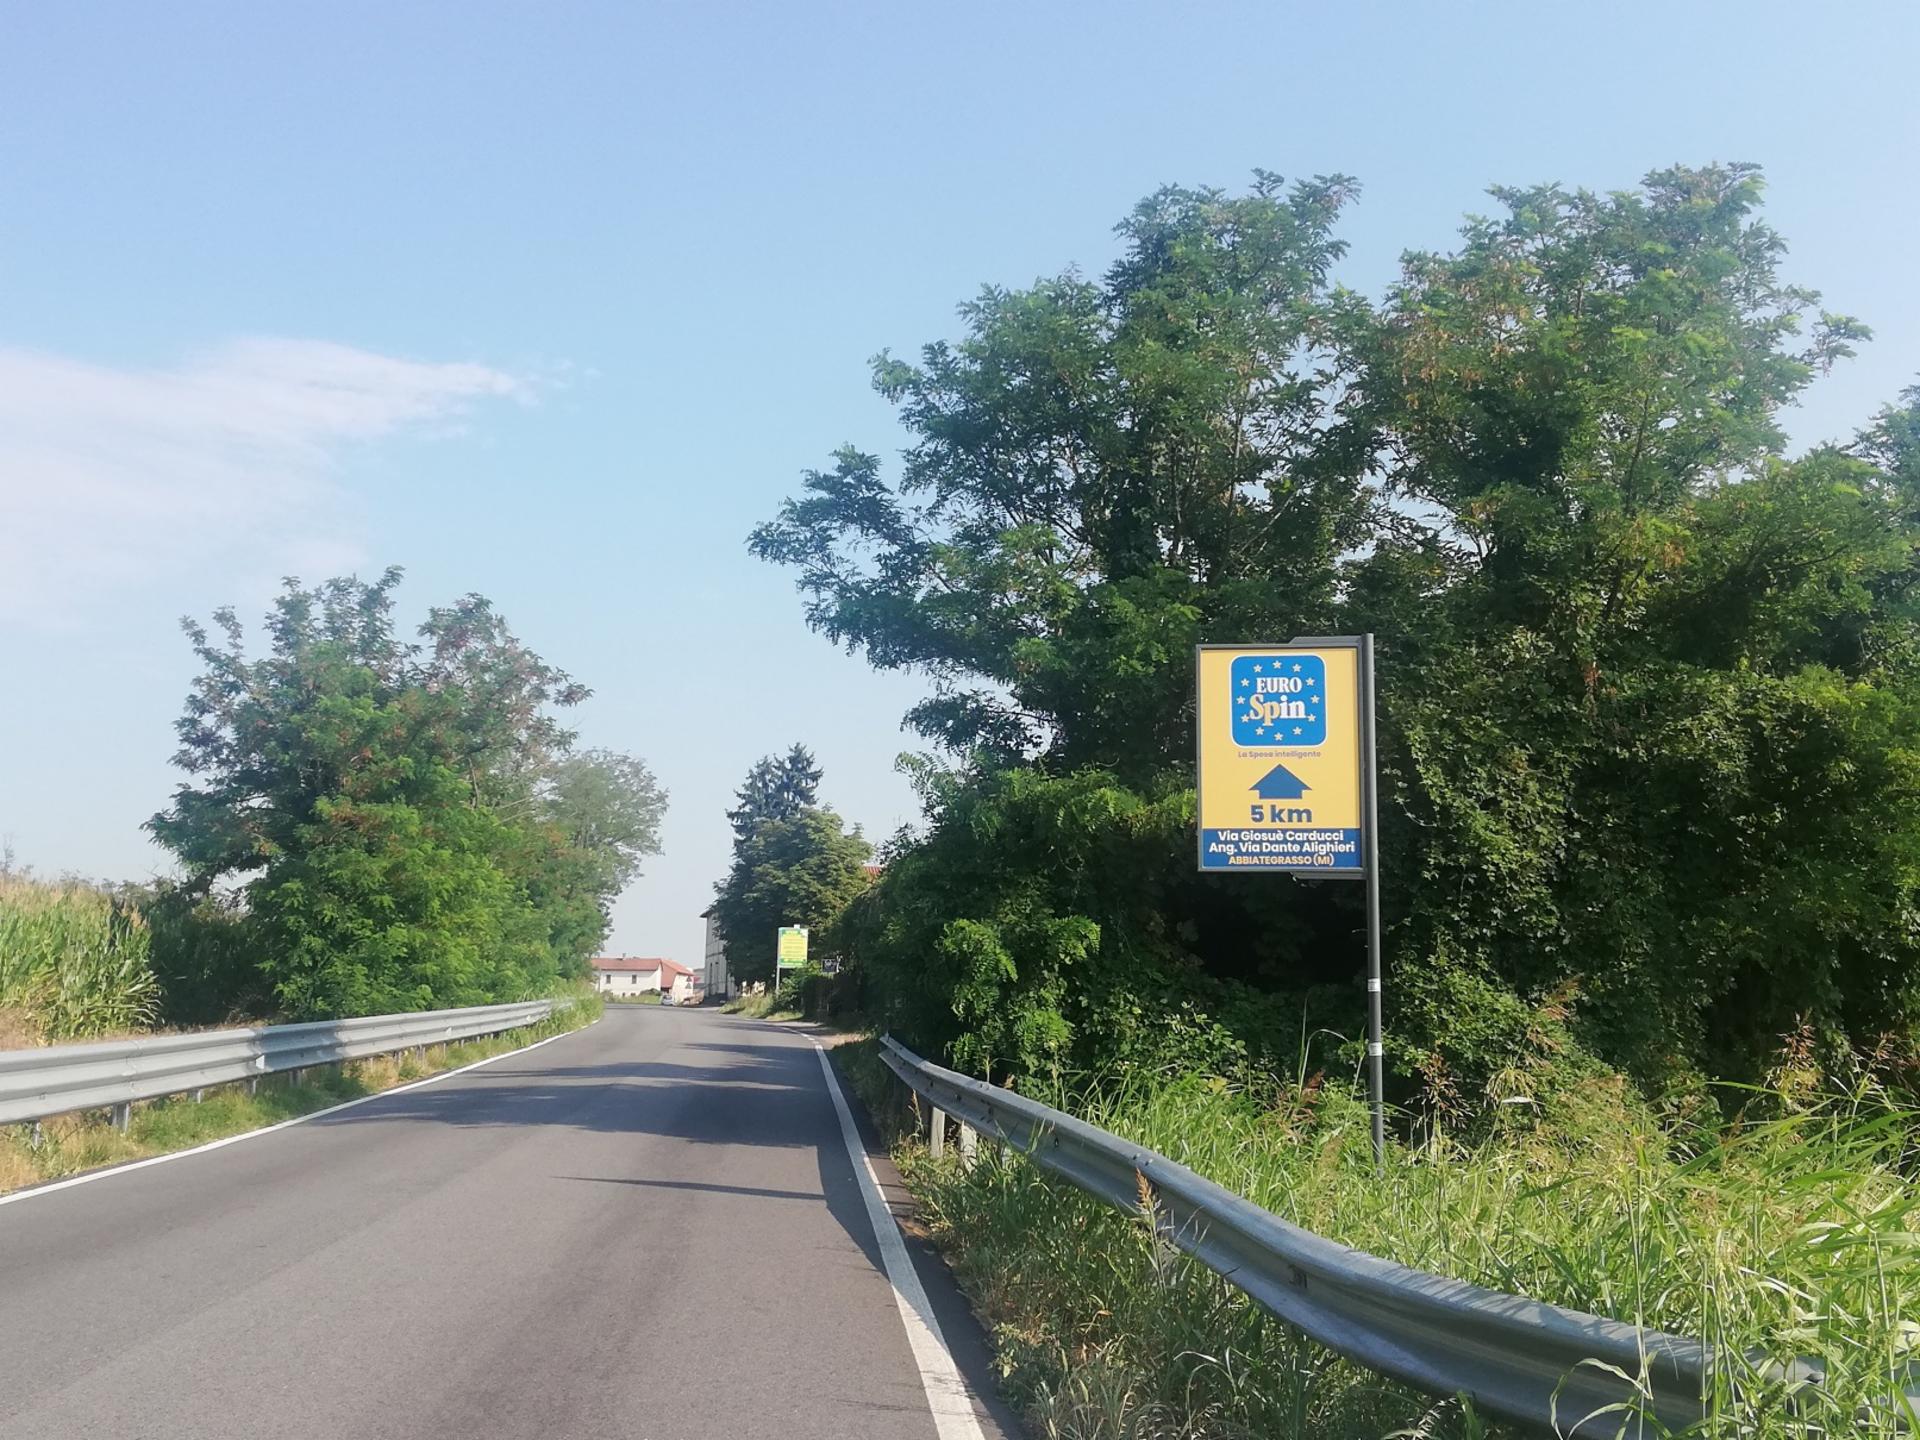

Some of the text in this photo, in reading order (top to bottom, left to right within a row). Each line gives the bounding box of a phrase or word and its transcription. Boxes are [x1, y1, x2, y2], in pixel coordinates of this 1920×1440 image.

[1256, 677, 1303, 693] EURO
[1249, 693, 1306, 727] Spin
[1250, 804, 1313, 823] 5 km
[1218, 830, 1344, 841] Via Giosuè Carducci
[1209, 841, 1356, 855] Ang. Via Dante Alighieri
[1228, 853, 1335, 866] ABBIATEGRASSO (MI)
